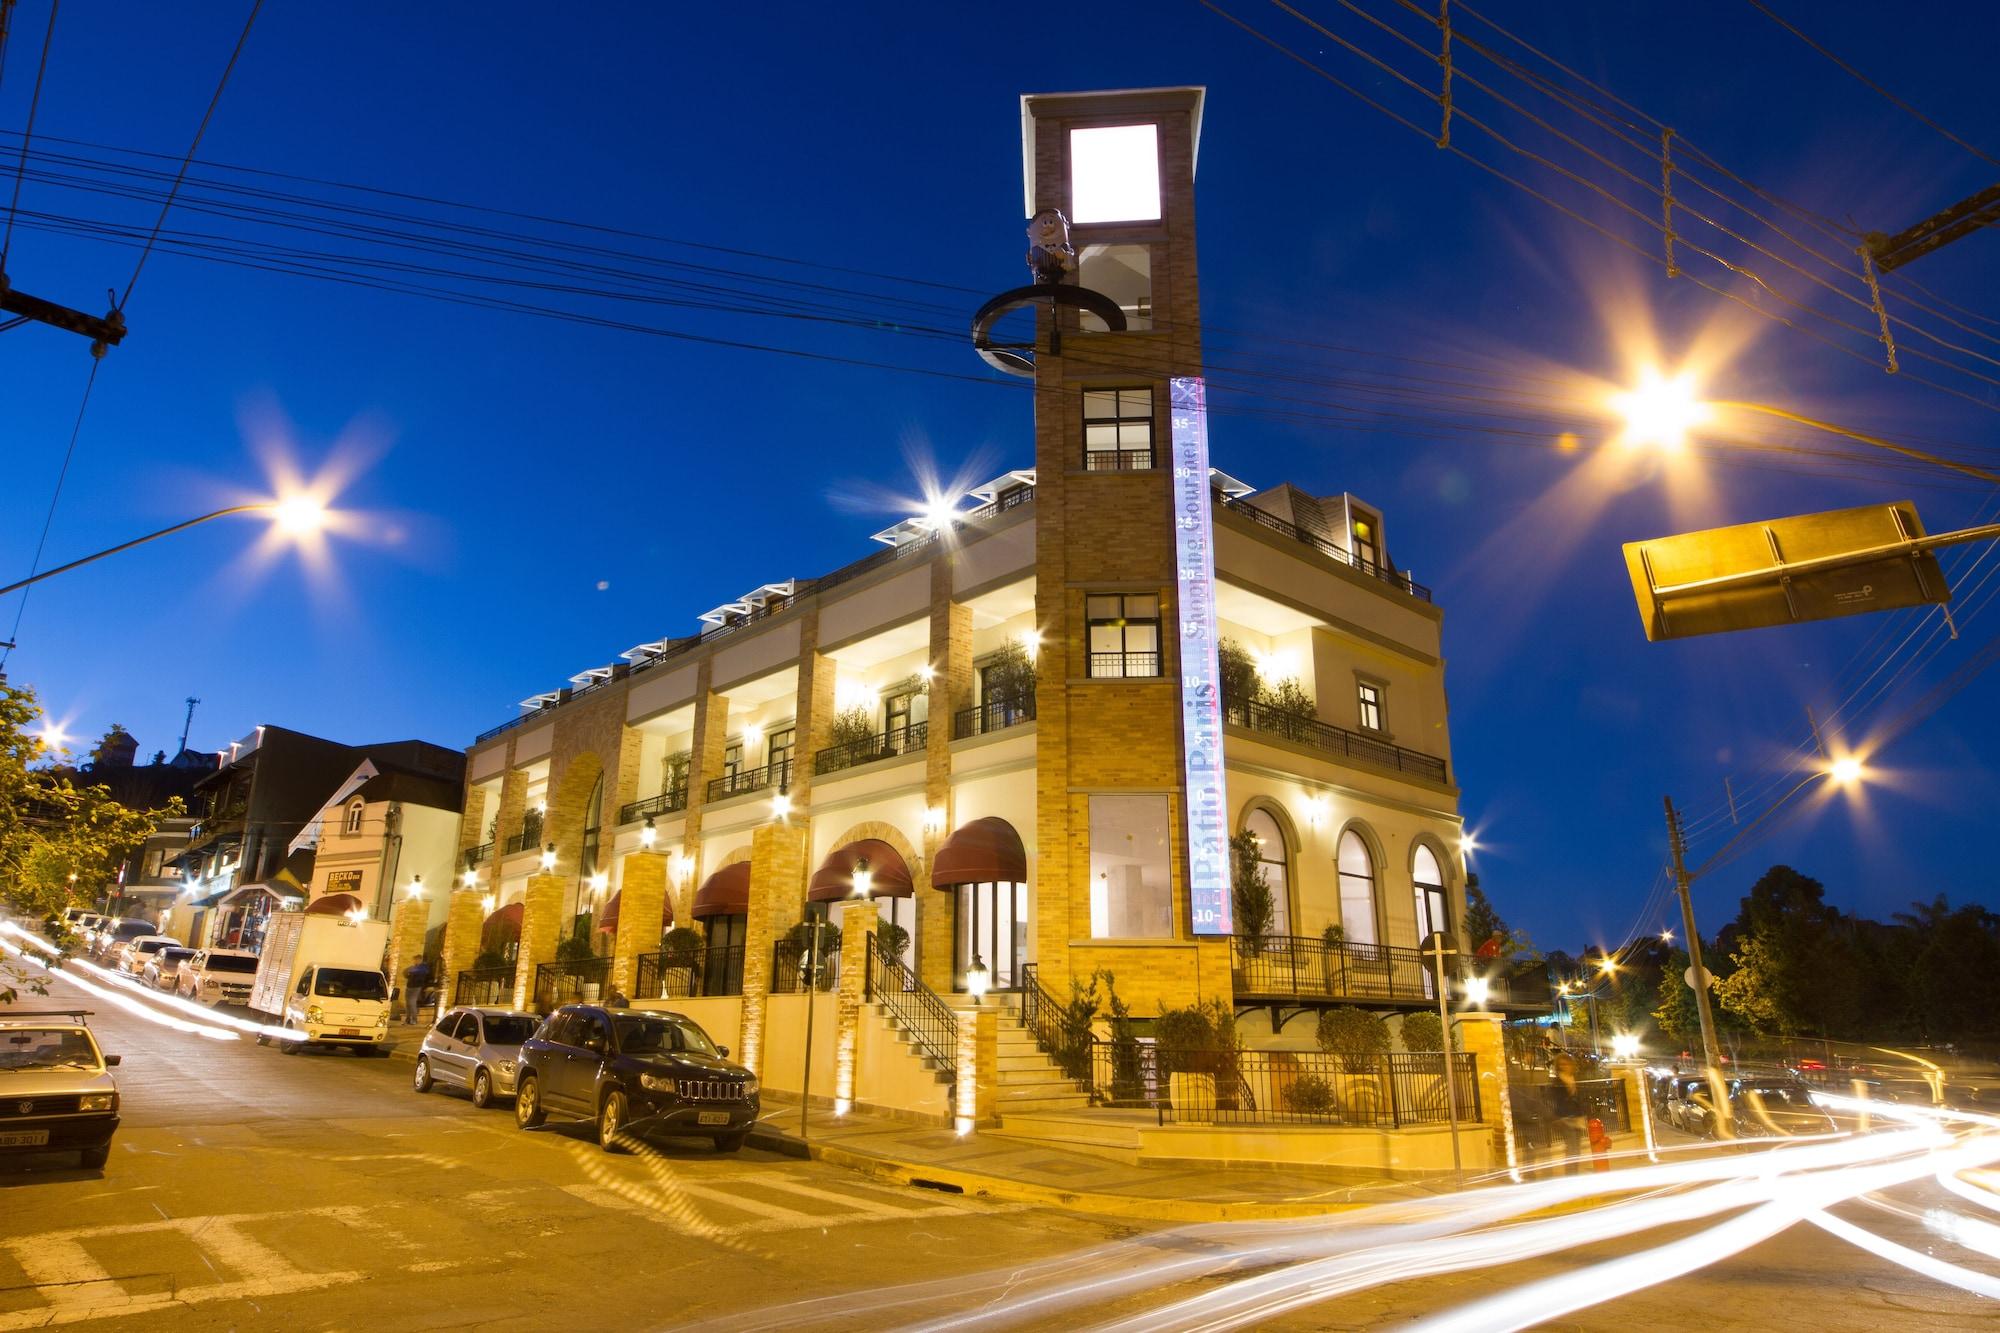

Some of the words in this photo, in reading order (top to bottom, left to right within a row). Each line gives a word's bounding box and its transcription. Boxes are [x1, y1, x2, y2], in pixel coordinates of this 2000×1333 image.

[1173, 419, 1188, 429] 35
[1175, 468, 1190, 478] 30
[1181, 441, 1201, 531] Gourmet
[1178, 518, 1192, 528] 25
[1180, 569, 1195, 580] 20
[1184, 538, 1208, 640] Shopping
[1183, 622, 1198, 633] 15
[1184, 676, 1200, 688] 10
[1187, 684, 1220, 775] Paris
[1192, 786, 1224, 882] Pátio
